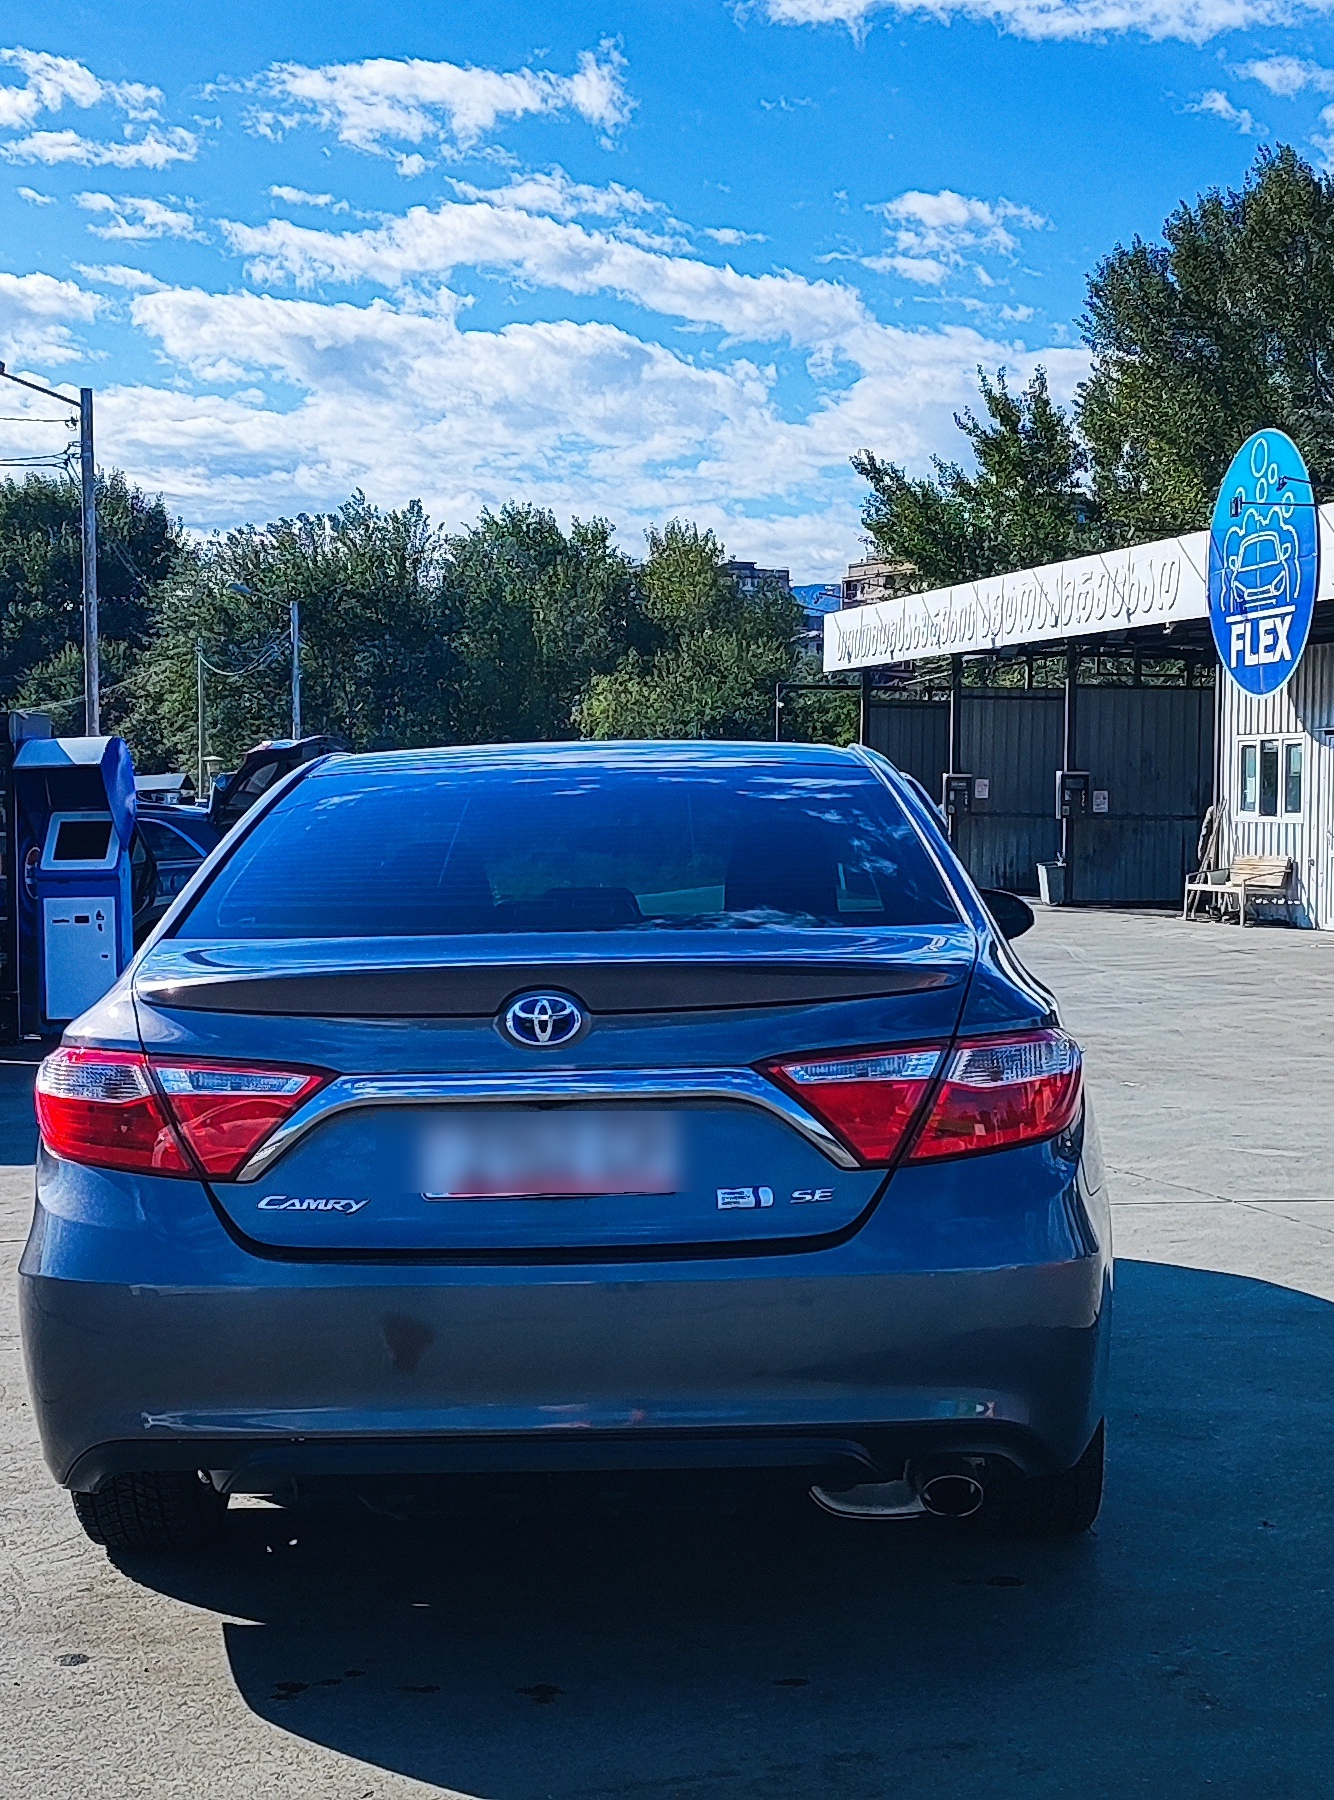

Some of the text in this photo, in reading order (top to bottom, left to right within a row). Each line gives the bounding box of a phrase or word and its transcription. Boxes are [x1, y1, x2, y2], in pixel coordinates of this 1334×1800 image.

[1230, 614, 1293, 669] FLEX
[257, 1195, 370, 1214] CAMRY
[789, 1186, 836, 1204] SE
